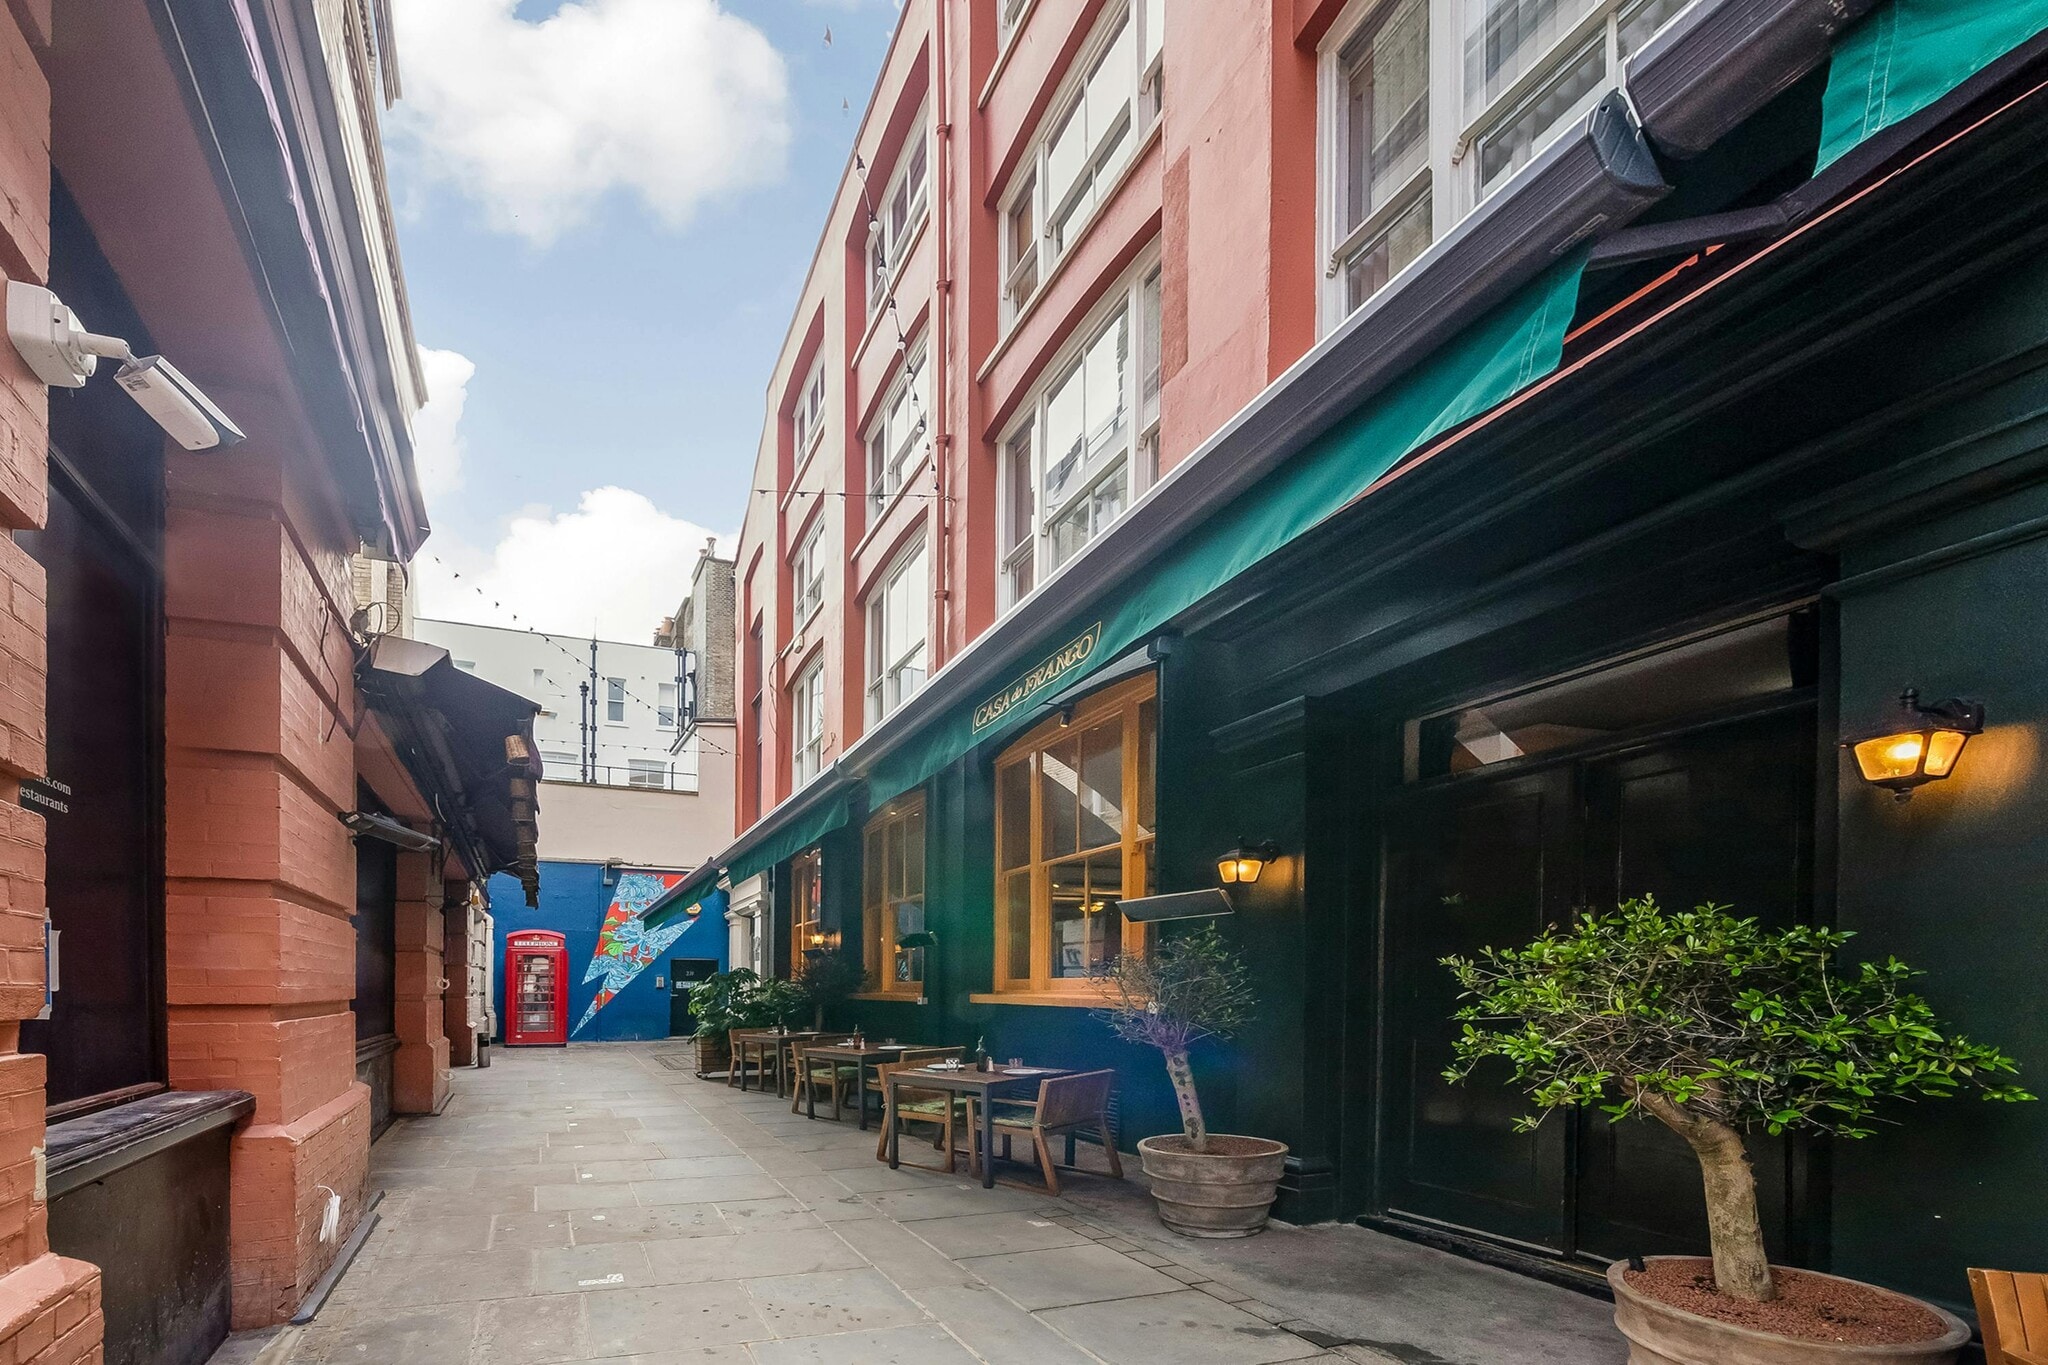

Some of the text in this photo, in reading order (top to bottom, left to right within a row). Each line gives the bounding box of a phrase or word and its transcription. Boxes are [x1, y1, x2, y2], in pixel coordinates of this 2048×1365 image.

[975, 692, 1010, 727] CASA
[1022, 633, 1094, 697] FRANGO
[19, 786, 69, 814] estaurants
